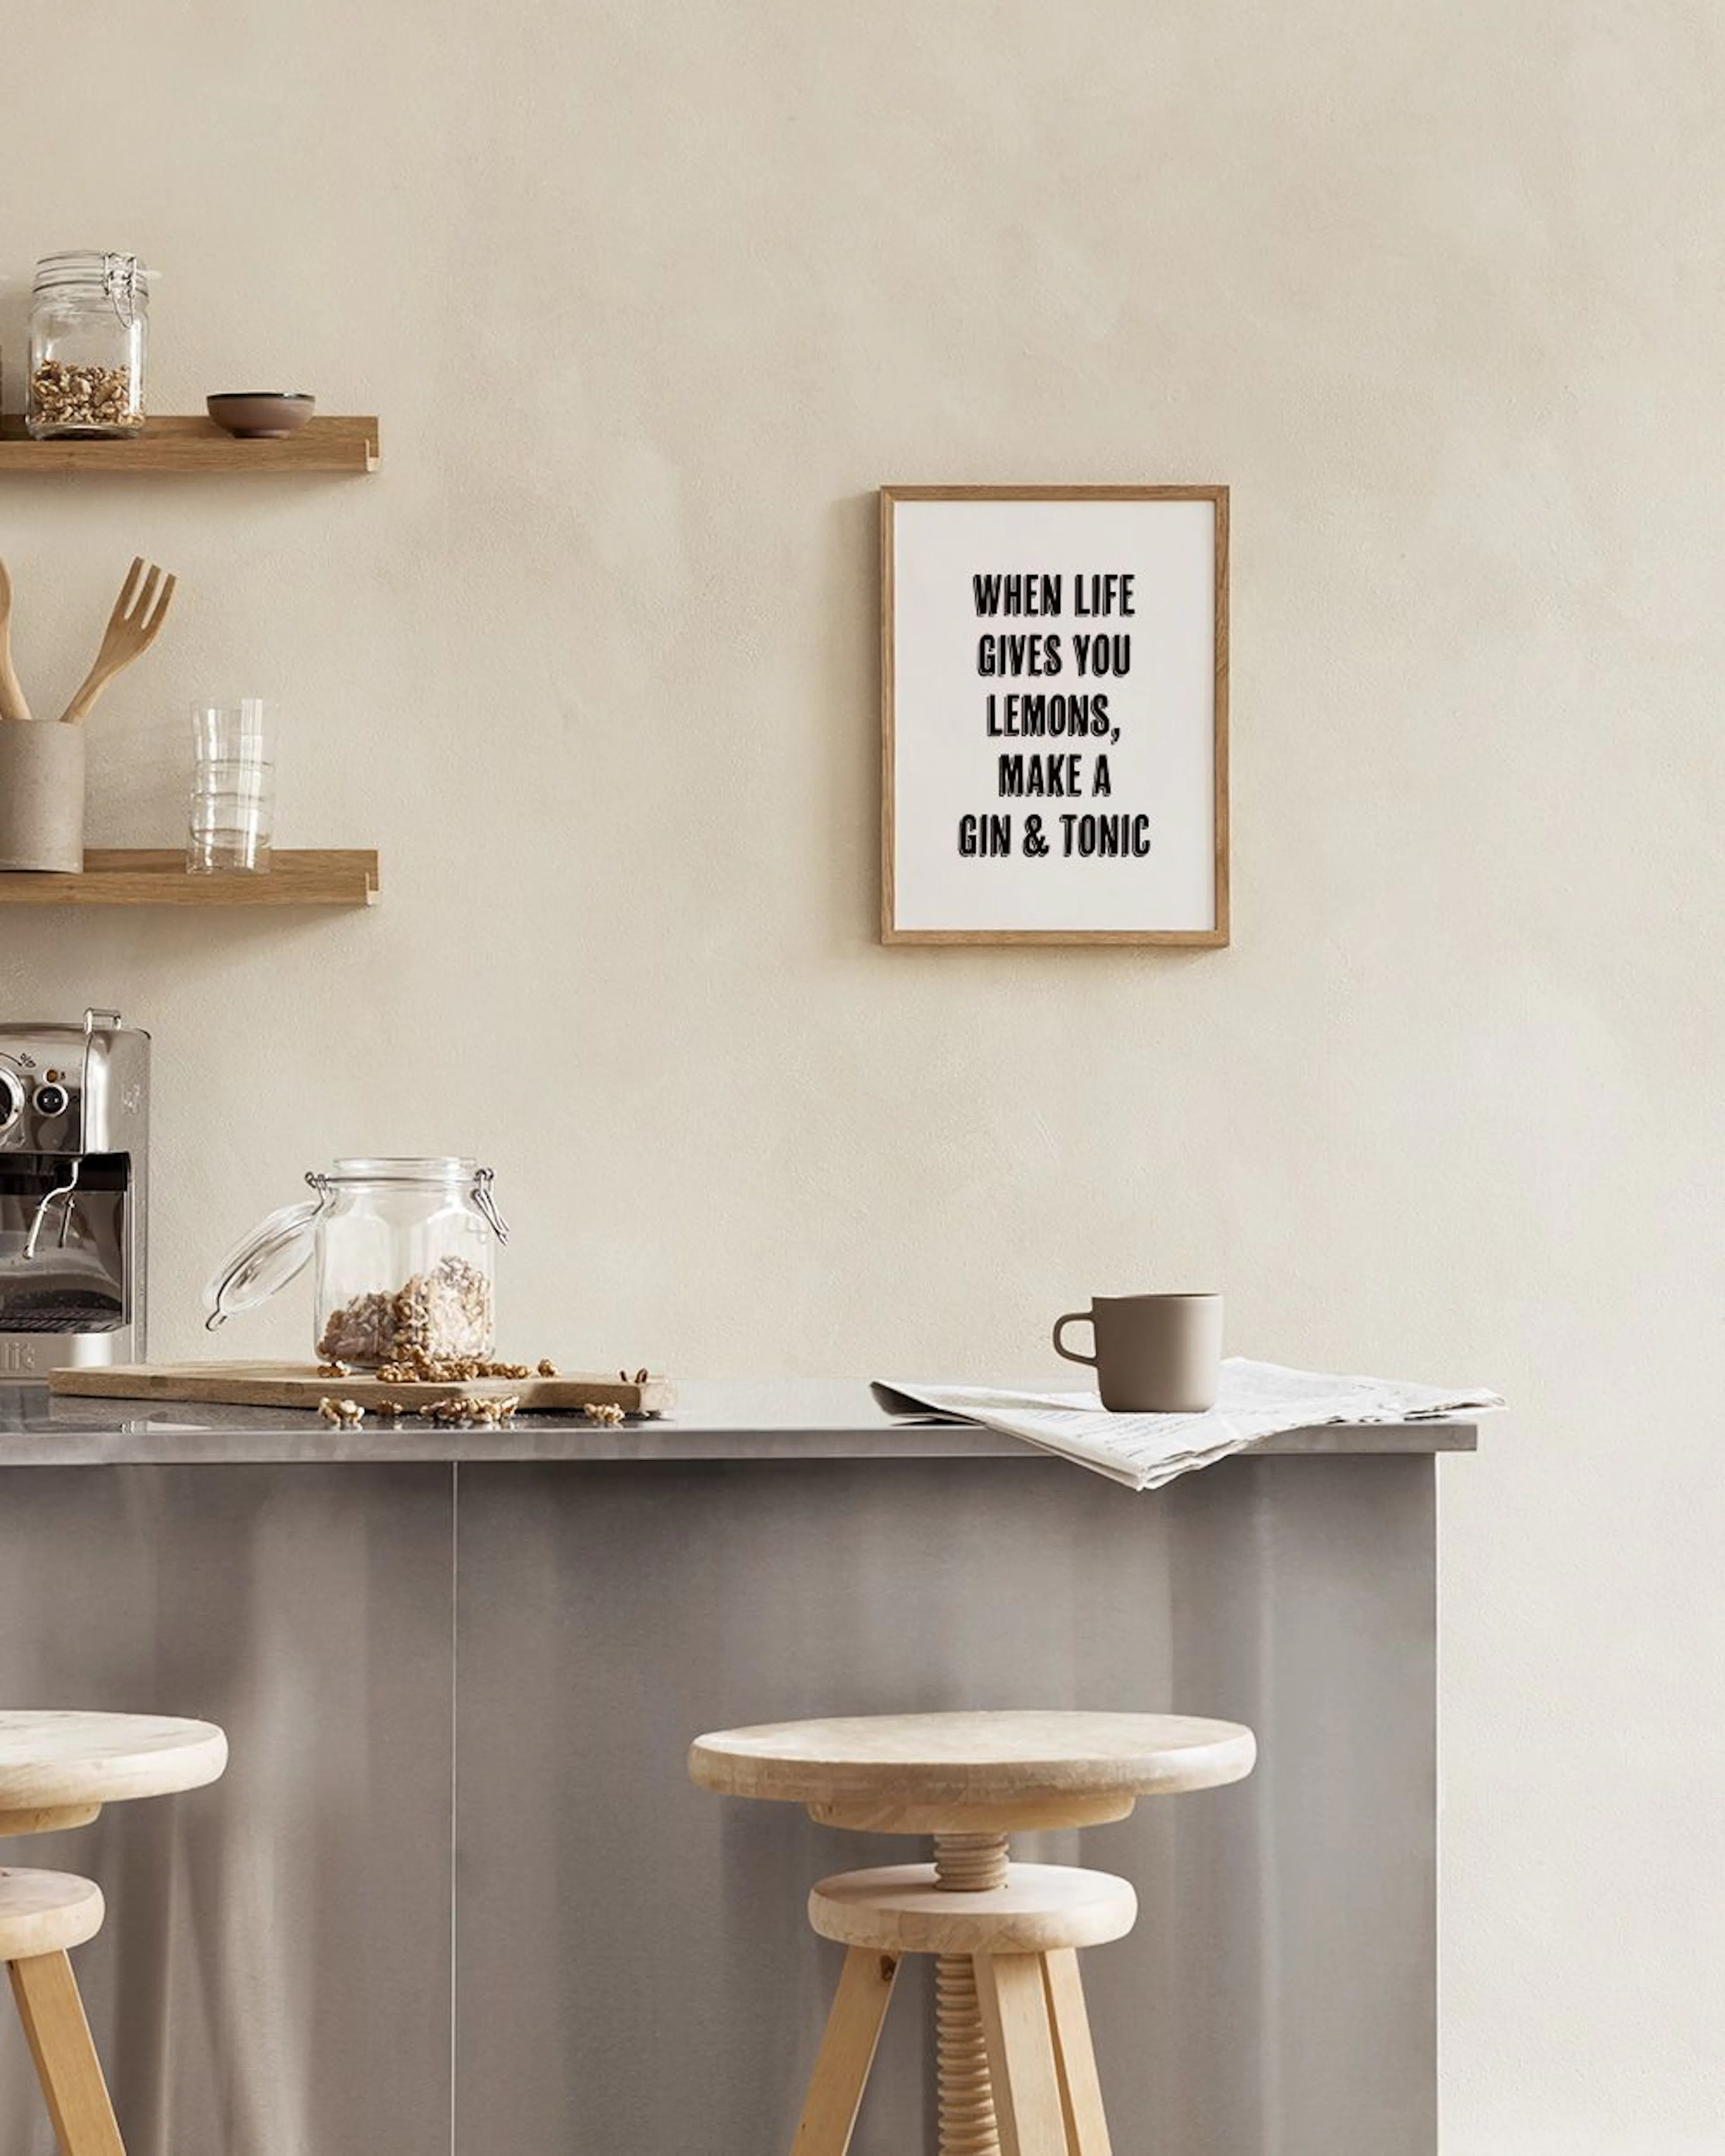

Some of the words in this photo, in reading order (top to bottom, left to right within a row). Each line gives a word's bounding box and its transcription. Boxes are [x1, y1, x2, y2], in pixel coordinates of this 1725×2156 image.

[972, 574, 1062, 617] WHEN
[1074, 574, 1136, 617] LIFE
[977, 634, 1063, 677] GIVES
[1072, 634, 1131, 677] YOU
[986, 694, 1120, 745] LEMONS,
[998, 754, 1082, 797] MAKE
[1092, 754, 1111, 797] A
[958, 814, 1011, 857] GIN
[1022, 814, 1050, 857] &
[1059, 814, 1151, 857] TONIC
